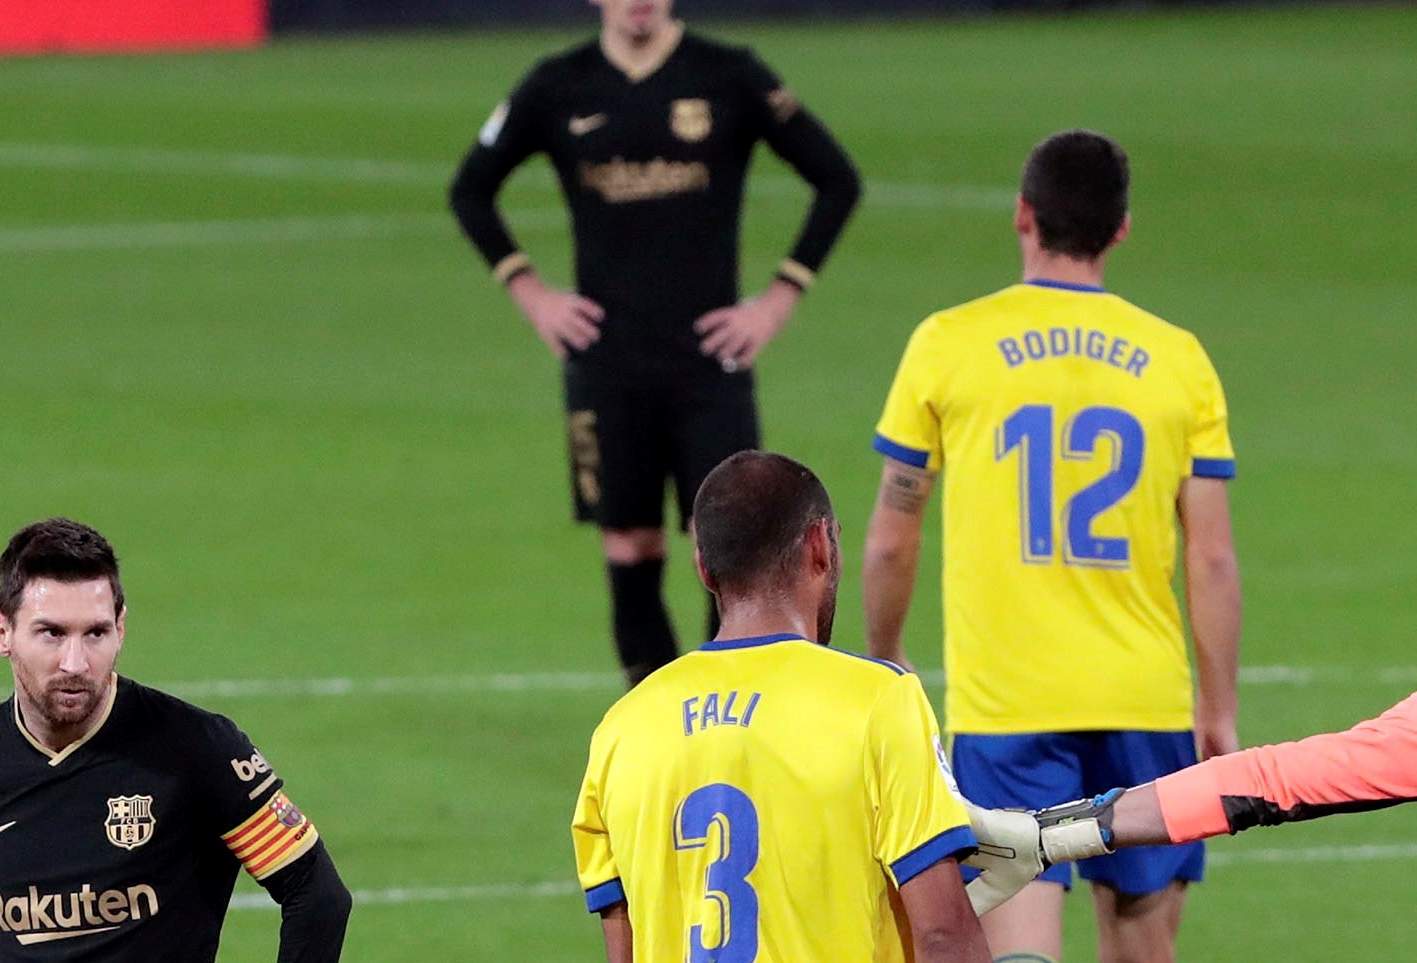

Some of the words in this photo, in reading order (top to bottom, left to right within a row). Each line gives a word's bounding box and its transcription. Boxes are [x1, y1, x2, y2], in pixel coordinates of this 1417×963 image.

[997, 327, 1150, 378] BODIGER
[995, 402, 1145, 570] 12
[682, 690, 762, 736] FALI
